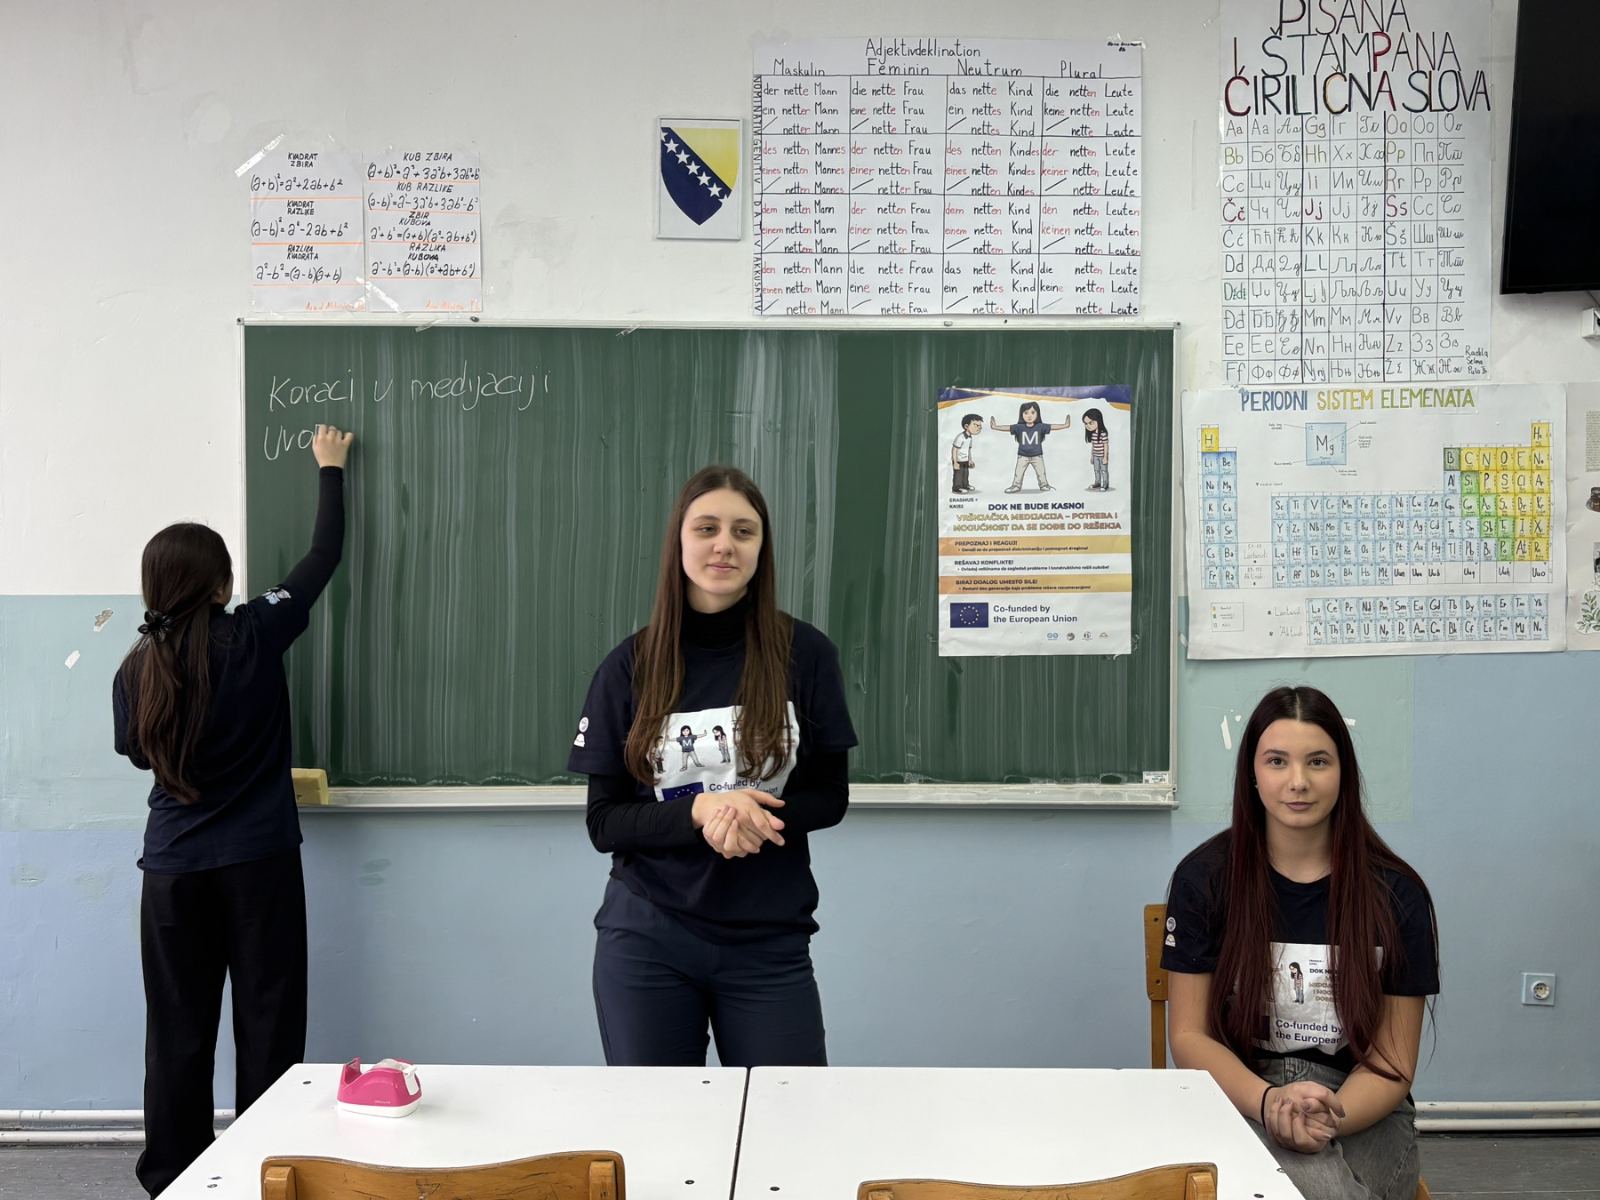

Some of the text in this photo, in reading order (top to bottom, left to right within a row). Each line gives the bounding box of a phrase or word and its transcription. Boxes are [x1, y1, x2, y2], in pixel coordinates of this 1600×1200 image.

[1279, 0, 1411, 35] PISANA
[866, 39, 980, 64] Adjektivdeklination
[1262, 27, 1461, 77] ŠTAMPANA
[773, 58, 1102, 79] Maskulin Feminin Neutrum Plural
[764, 82, 837, 95] der nette Mann
[852, 81, 924, 96] die nette Frau
[950, 81, 1033, 97] das nette Kind
[1046, 83, 1133, 98] die netten Leute
[1402, 70, 1491, 113] SLOVA
[763, 102, 838, 116] ein netter Mann
[873, 102, 896, 115] nette
[903, 101, 924, 115] Frau
[949, 102, 1033, 116] ein nettes Kind
[1070, 103, 1100, 117] netten
[1106, 103, 1134, 116] Leute
[783, 122, 839, 134] netter Mann
[872, 119, 928, 134] nette Frau
[971, 120, 1035, 136] nettes Kind
[1072, 123, 1134, 137] nette Leute
[403, 153, 421, 161] KUB
[785, 202, 810, 214] netten
[815, 200, 834, 214] Mann
[878, 202, 906, 214] netten
[911, 203, 930, 214] Frau
[1009, 202, 1030, 215] Kind
[1073, 202, 1099, 216] netten
[1106, 202, 1140, 216] Leuten
[784, 262, 810, 274] netten
[815, 258, 842, 274] Mann
[850, 260, 933, 274] die nette Frau
[945, 260, 1034, 275] das nette Kind
[1040, 261, 1137, 275] die netten Leute
[270, 369, 354, 412] Koraci
[412, 360, 550, 411] medijaciji
[1240, 388, 1475, 411] PERIODNI SISTEM ELEMENATA
[1022, 431, 1039, 445] M
[993, 605, 1050, 614] Co-funded by
[1009, 616, 1049, 624] European
[1276, 1020, 1343, 1035] Co-funded by
[1276, 1031, 1291, 1039] the
